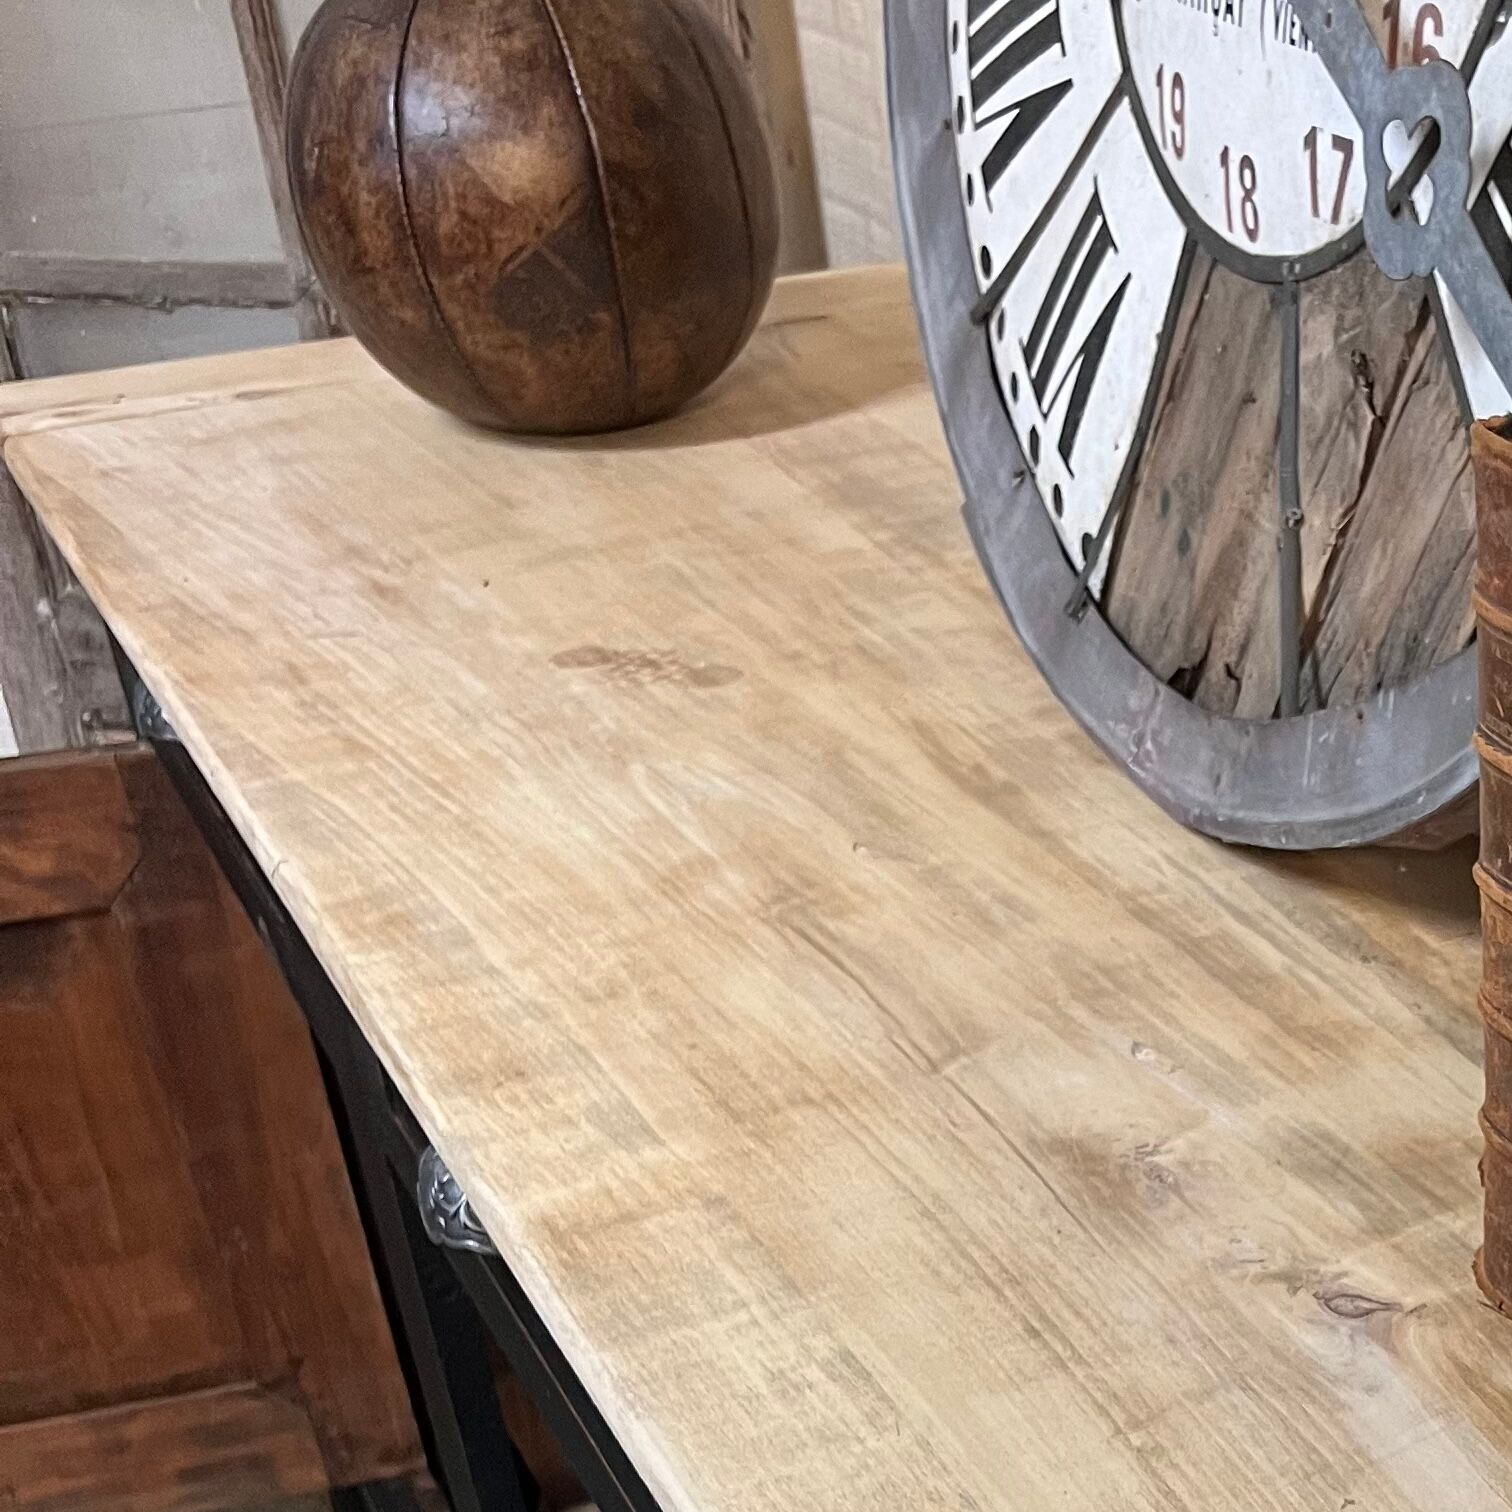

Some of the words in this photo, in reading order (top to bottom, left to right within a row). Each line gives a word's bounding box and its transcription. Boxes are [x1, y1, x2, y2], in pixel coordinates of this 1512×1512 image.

[1382, 1, 1444, 71] 16
[1156, 63, 1185, 161] 19
[1220, 145, 1260, 243] 18
[1304, 125, 1354, 226] 17
